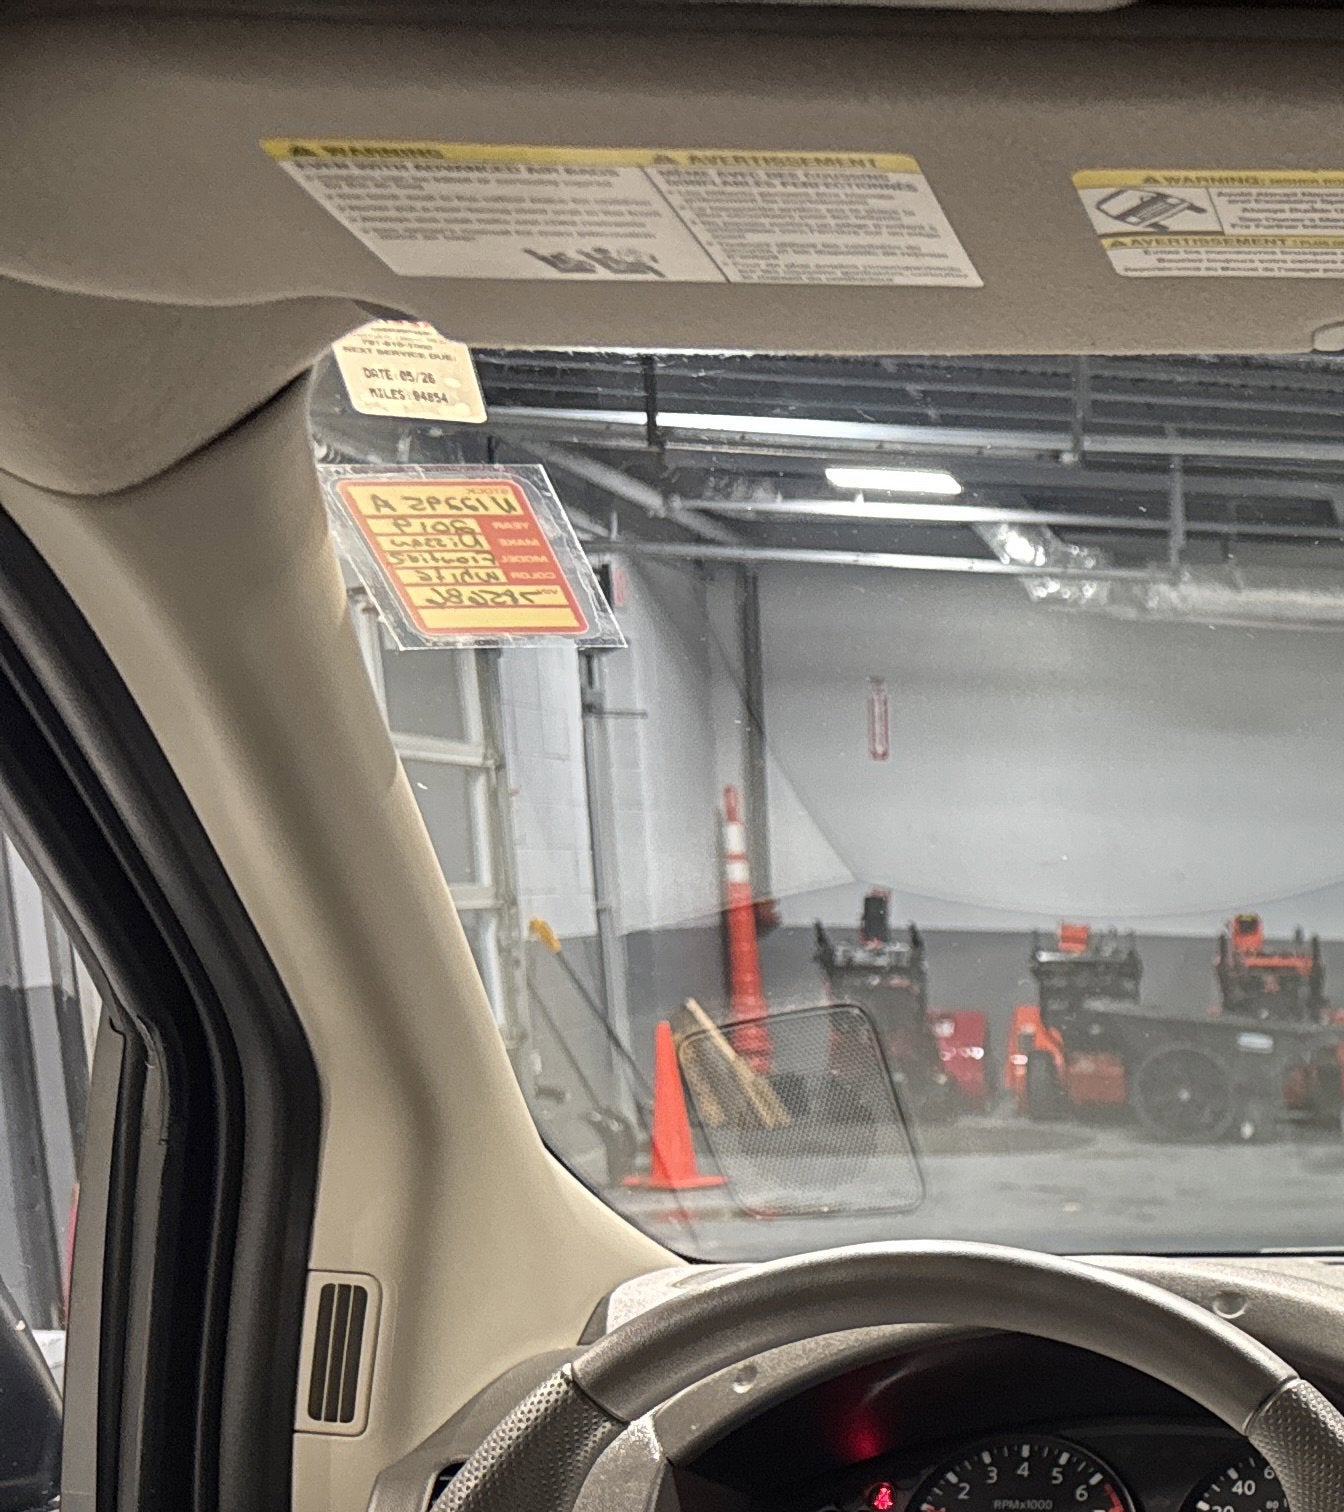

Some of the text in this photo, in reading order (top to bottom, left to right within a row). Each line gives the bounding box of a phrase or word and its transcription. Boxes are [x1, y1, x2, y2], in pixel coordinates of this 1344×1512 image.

[986, 1467, 998, 1484] 3
[1016, 1462, 1030, 1478] 4
[1052, 1467, 1064, 1484] 5
[1263, 1466, 1275, 1479] 6
[958, 1483, 970, 1499] 2
[1075, 1485, 1088, 1501] 6
[1231, 1480, 1256, 1495] 40
